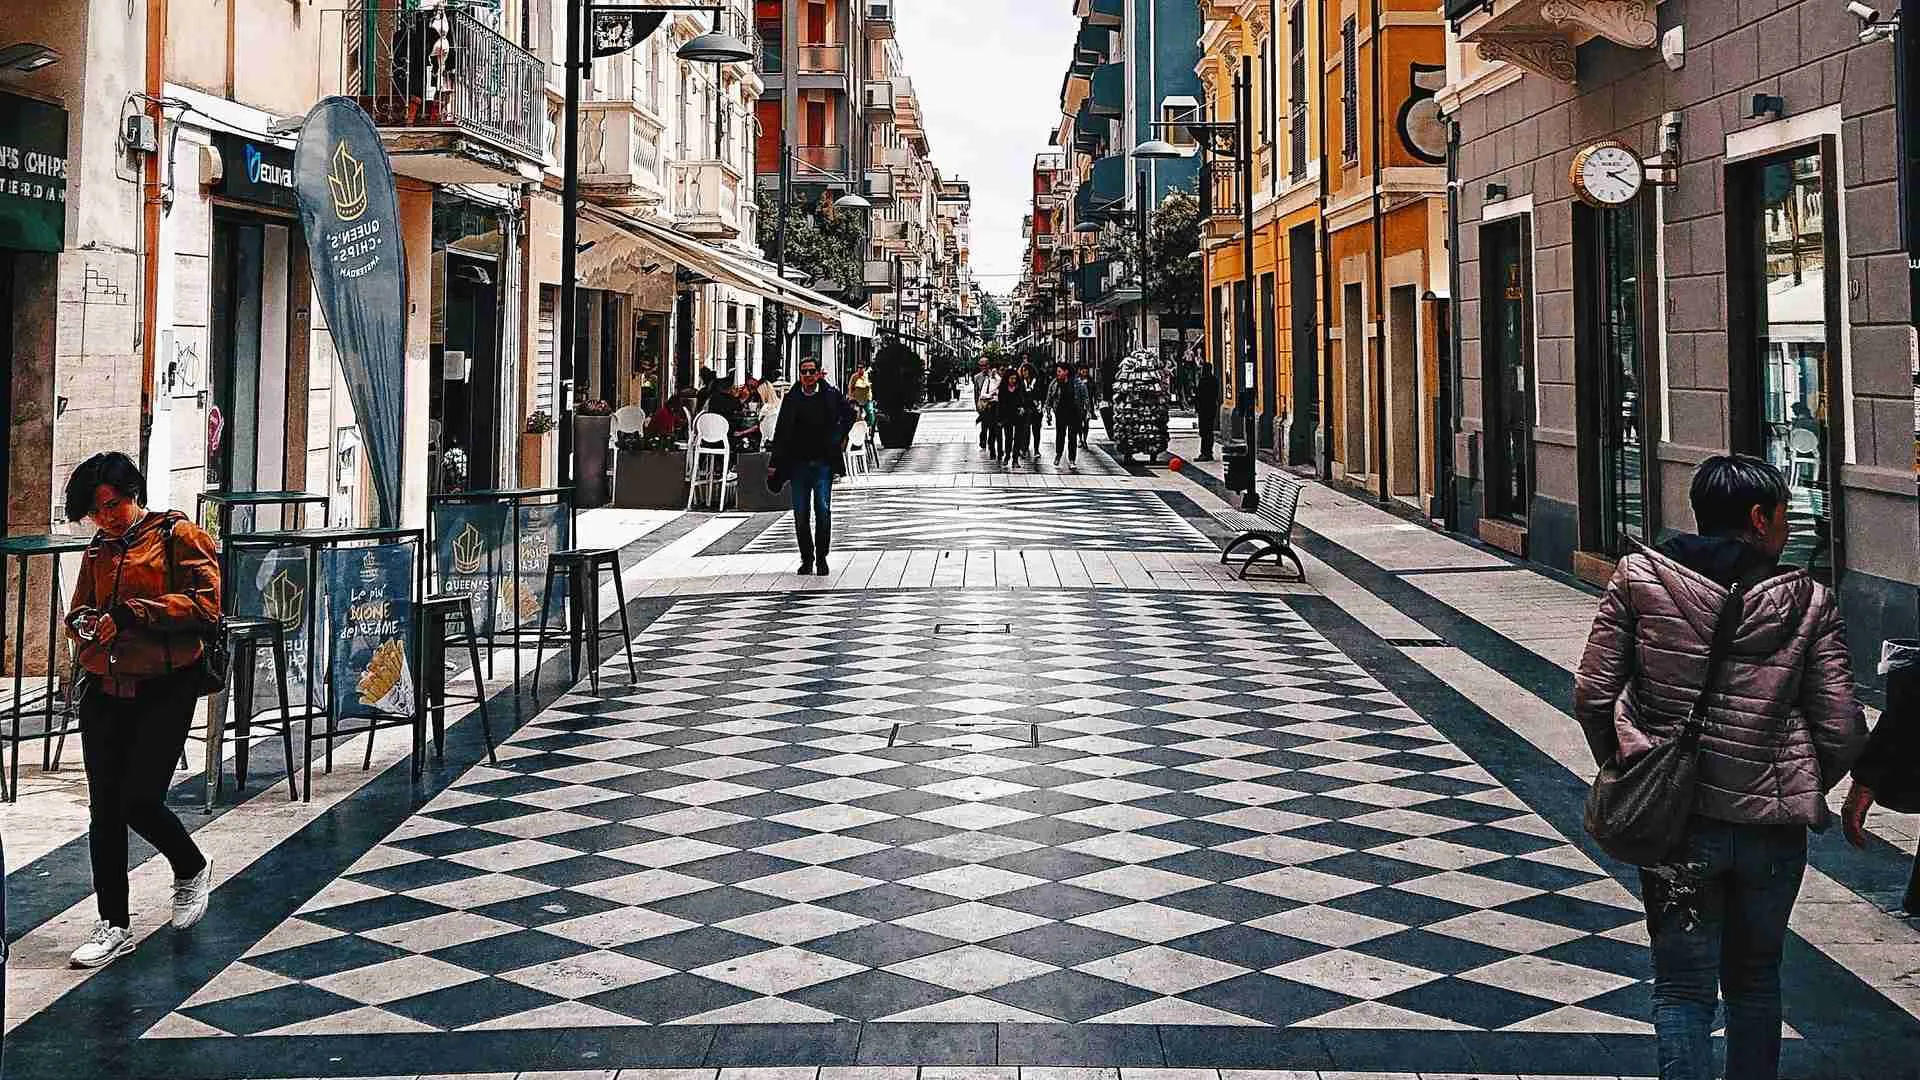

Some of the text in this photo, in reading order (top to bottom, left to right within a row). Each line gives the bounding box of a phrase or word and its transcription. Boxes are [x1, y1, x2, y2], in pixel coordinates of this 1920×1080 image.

[24, 152, 68, 179] CHIPS
[445, 580, 489, 591] QUEEN'S
[360, 620, 399, 635] REAME
